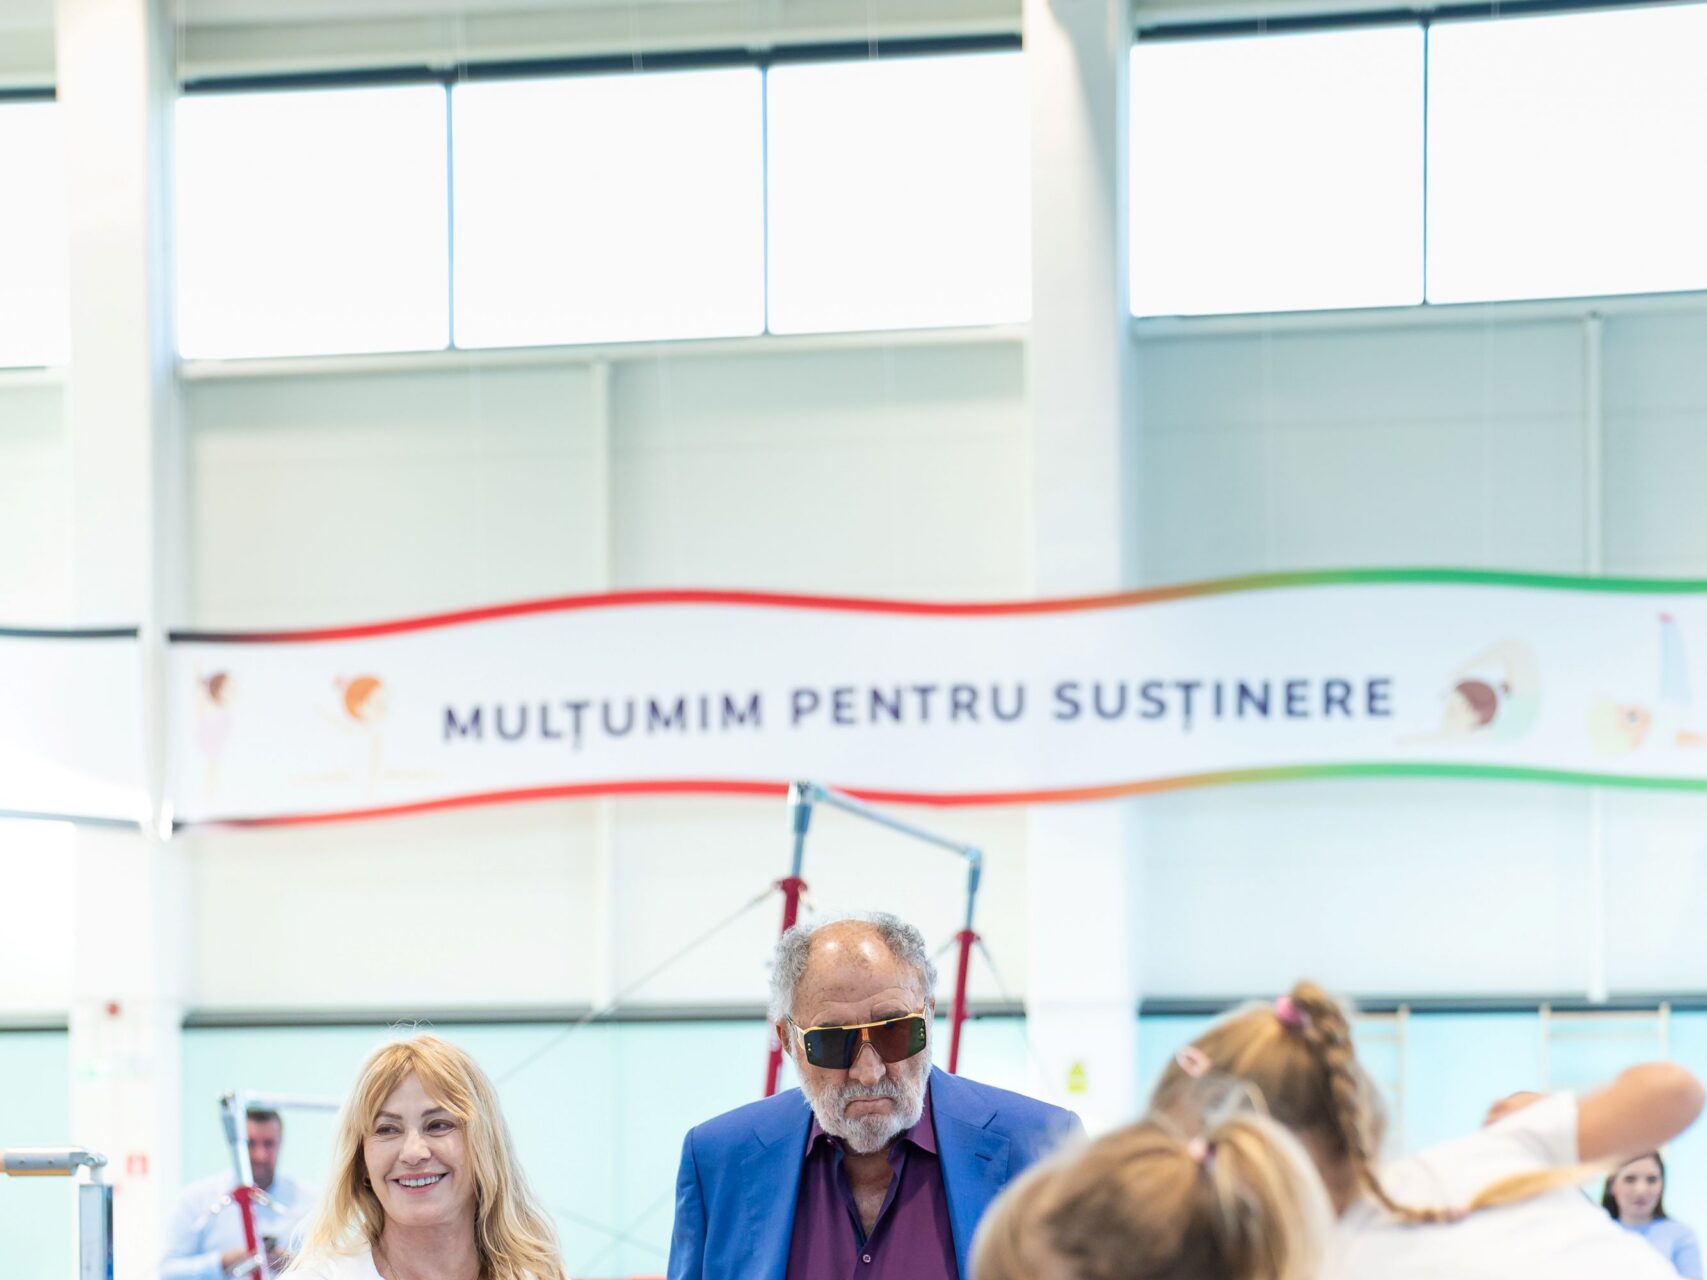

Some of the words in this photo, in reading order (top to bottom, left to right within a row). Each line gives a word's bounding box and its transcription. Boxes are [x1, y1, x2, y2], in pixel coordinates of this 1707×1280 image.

[443, 691, 763, 751] MULȚUMIM
[790, 683, 1025, 727] PENTRU
[1053, 676, 1393, 732] SUSȚINERE
